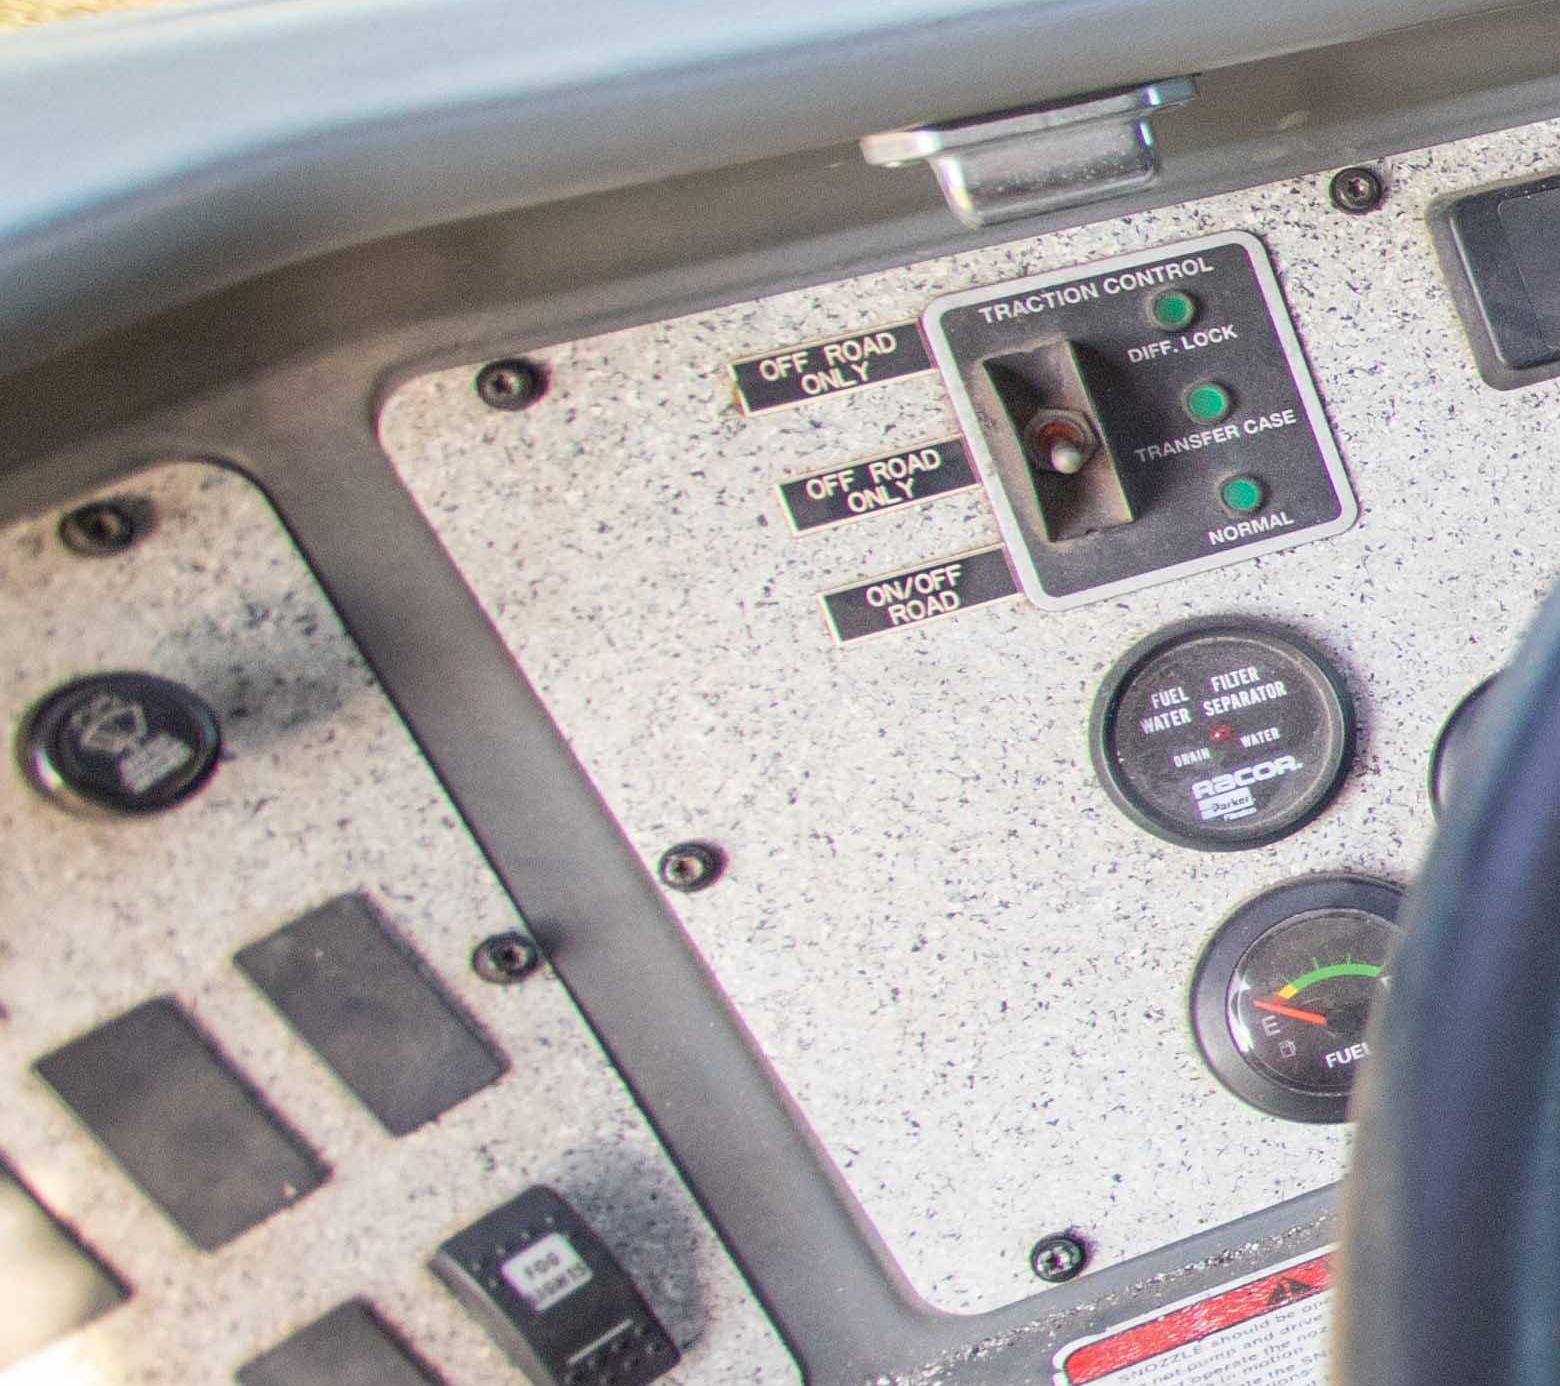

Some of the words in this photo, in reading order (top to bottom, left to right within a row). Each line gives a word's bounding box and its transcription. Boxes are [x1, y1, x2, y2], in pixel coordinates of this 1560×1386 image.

[979, 282, 1099, 326] TRACTION
[1103, 256, 1214, 296] CONTROL
[759, 347, 808, 383] OFF
[822, 332, 897, 366] ROAD
[1127, 338, 1179, 363] DIFF.
[1182, 324, 1238, 351] LOCK
[801, 361, 871, 396] ONLY
[1134, 424, 1239, 463] TRANSFER
[1243, 410, 1297, 436] CASE
[805, 462, 854, 501] OFF
[868, 449, 941, 482] ROAD
[847, 478, 916, 513] ONLY
[1209, 511, 1294, 545] NORMAL
[865, 564, 962, 609] ON/OFF
[887, 590, 960, 626] ROAD
[1141, 708, 1191, 735] WATER
[1203, 680, 1286, 717] SEPARATOR
[1150, 686, 1189, 709] FUEL
[1210, 666, 1260, 692] FILTER
[1174, 747, 1210, 767] DRAIN
[1240, 727, 1280, 748] WATER
